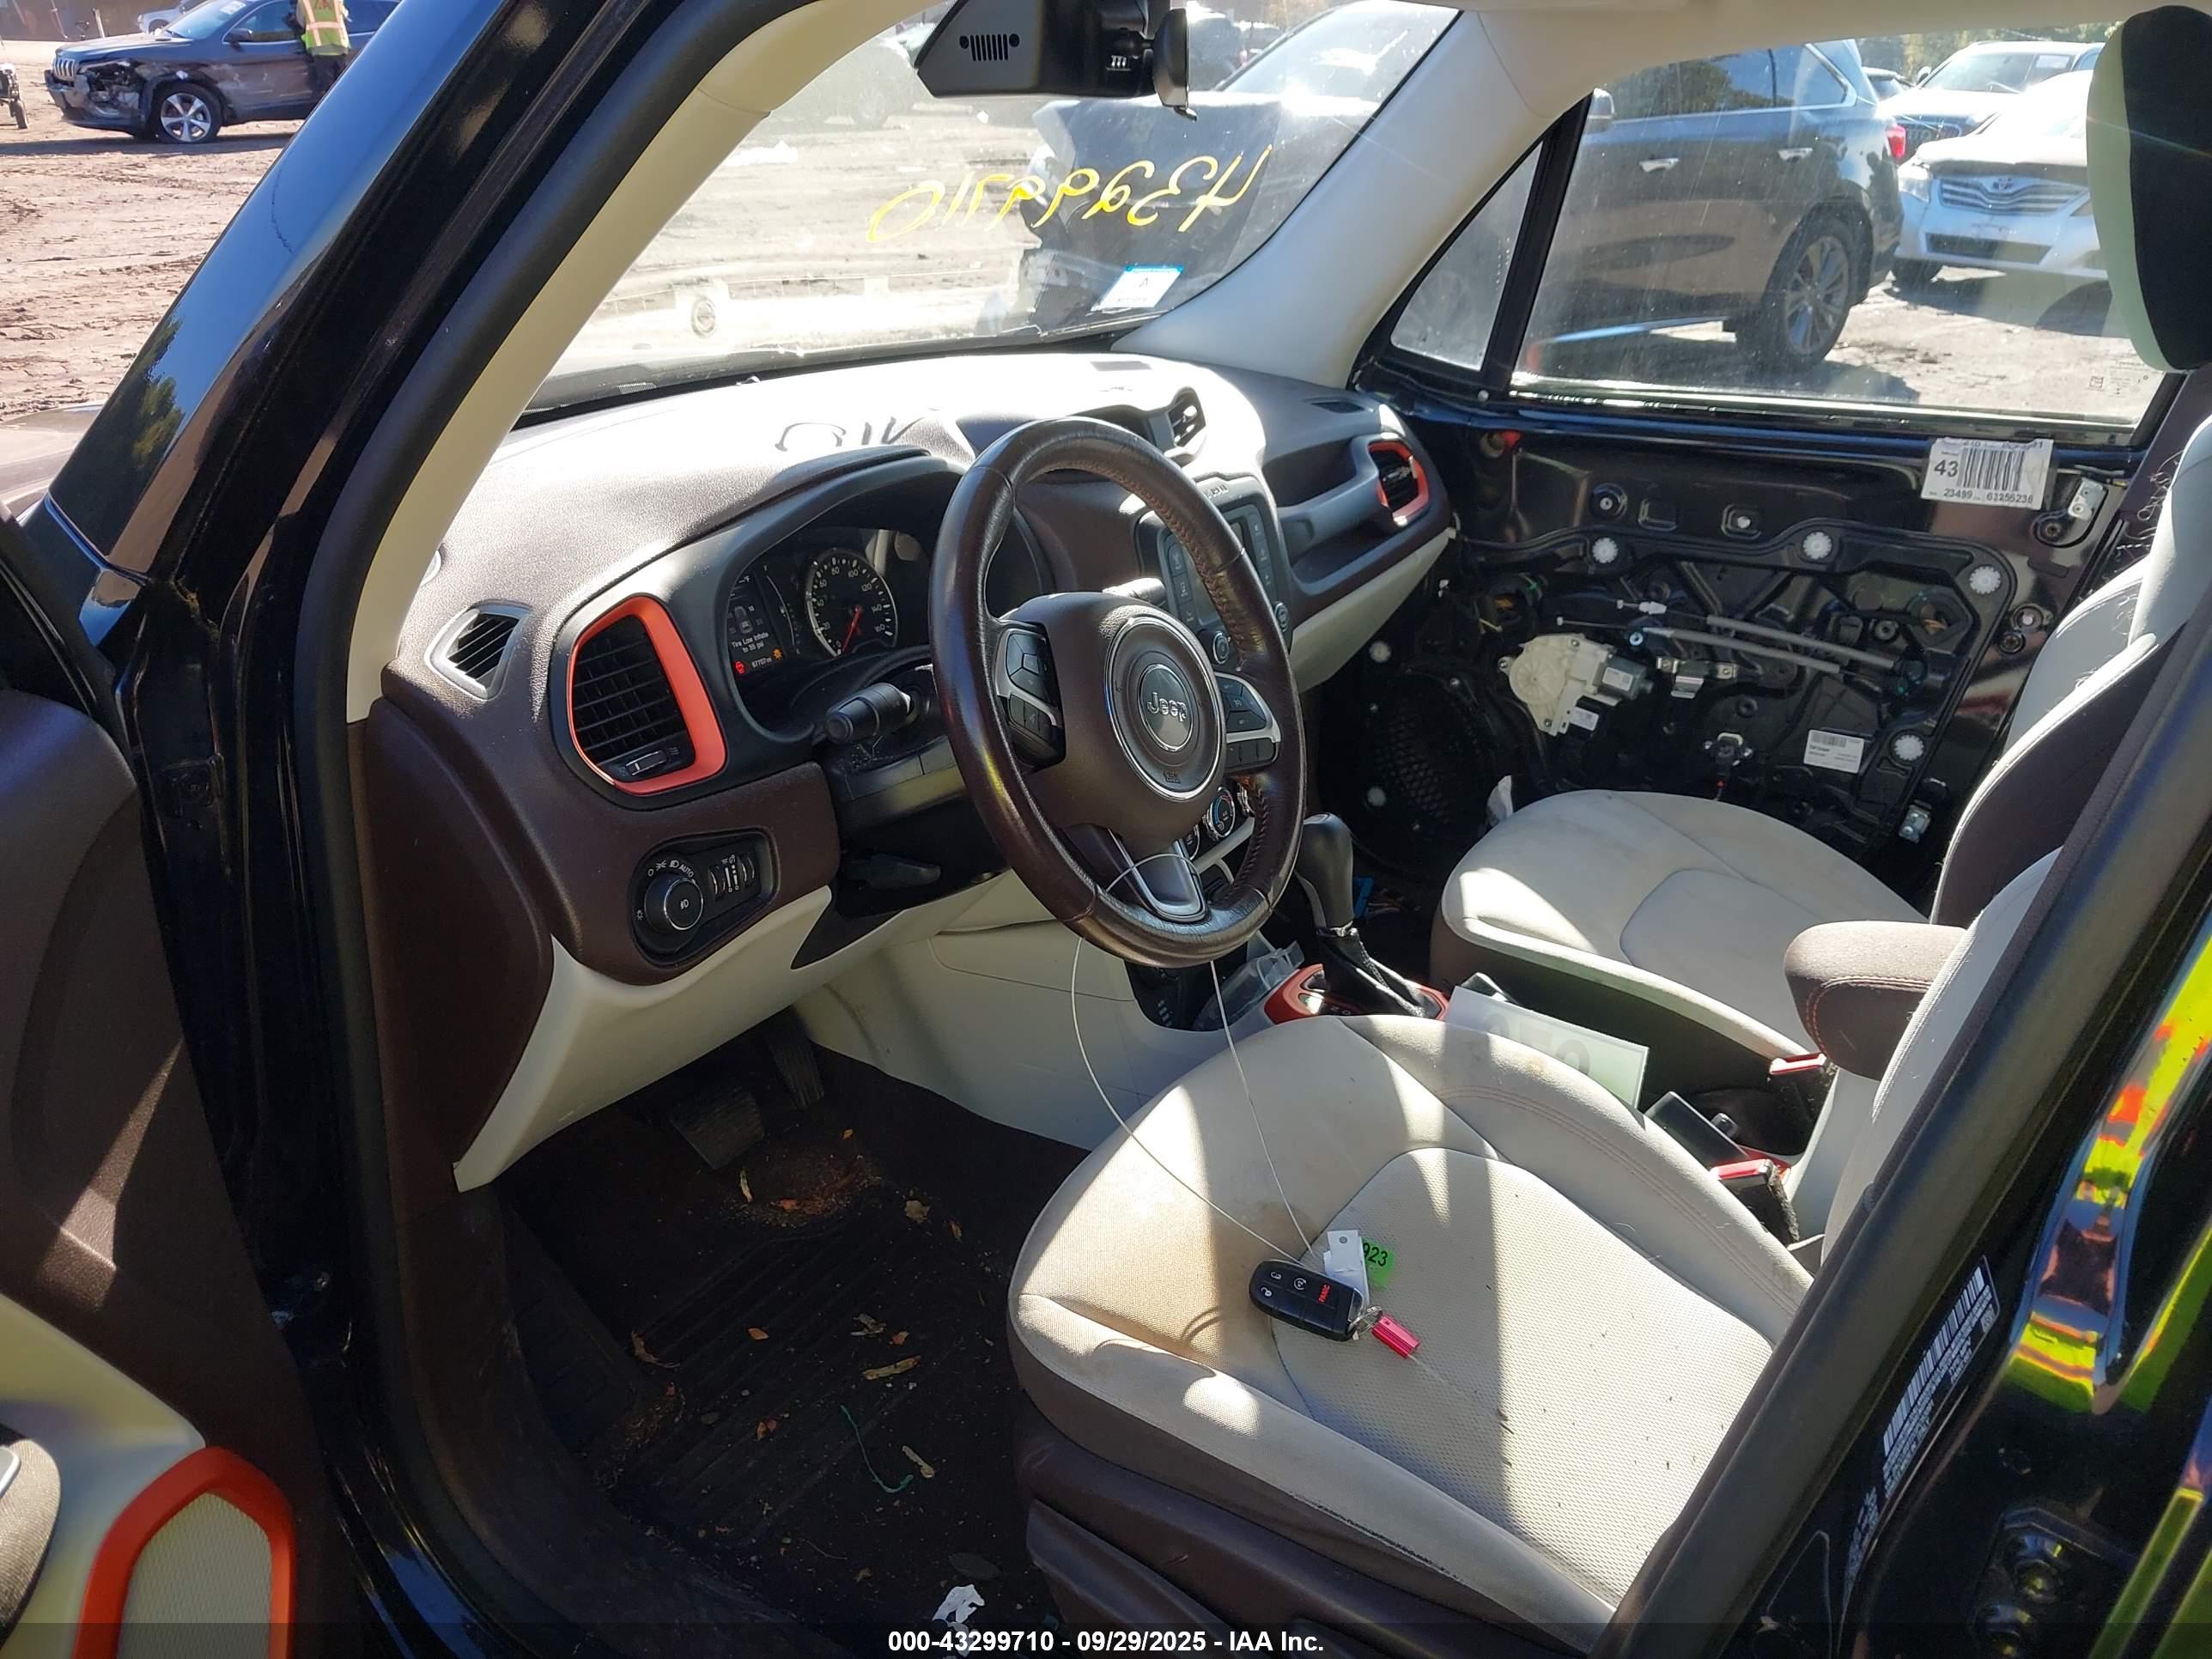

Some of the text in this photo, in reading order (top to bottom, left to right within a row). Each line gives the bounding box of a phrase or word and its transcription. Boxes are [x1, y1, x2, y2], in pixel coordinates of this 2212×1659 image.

[1934, 459, 1959, 477] 43
[861, 582, 872, 592] 120
[1146, 691, 1188, 722] Jeep
[678, 864, 694, 878] AUTO
